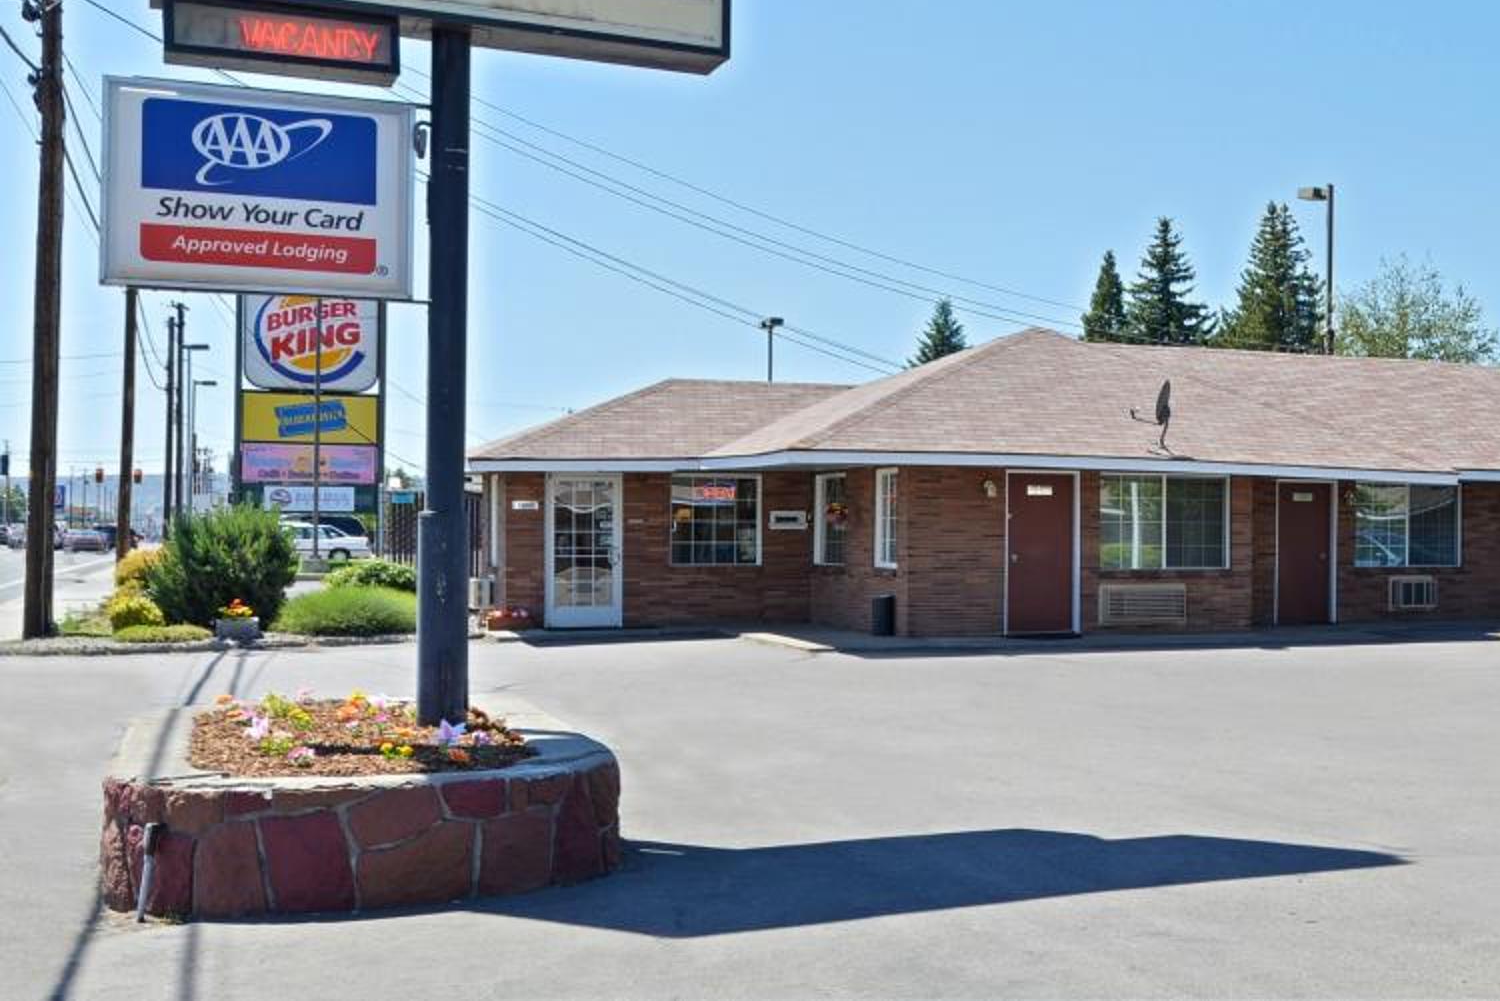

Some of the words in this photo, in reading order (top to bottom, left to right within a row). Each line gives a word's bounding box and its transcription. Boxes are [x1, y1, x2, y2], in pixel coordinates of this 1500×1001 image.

[238, 16, 378, 59] VACANCY
[204, 116, 283, 168] AAA
[156, 196, 235, 222] Show
[241, 202, 299, 227] Your
[304, 208, 365, 232] Card
[172, 235, 269, 255] Approved
[272, 241, 348, 264] Lodging
[267, 302, 357, 332] BURGER
[271, 322, 361, 361] KING
